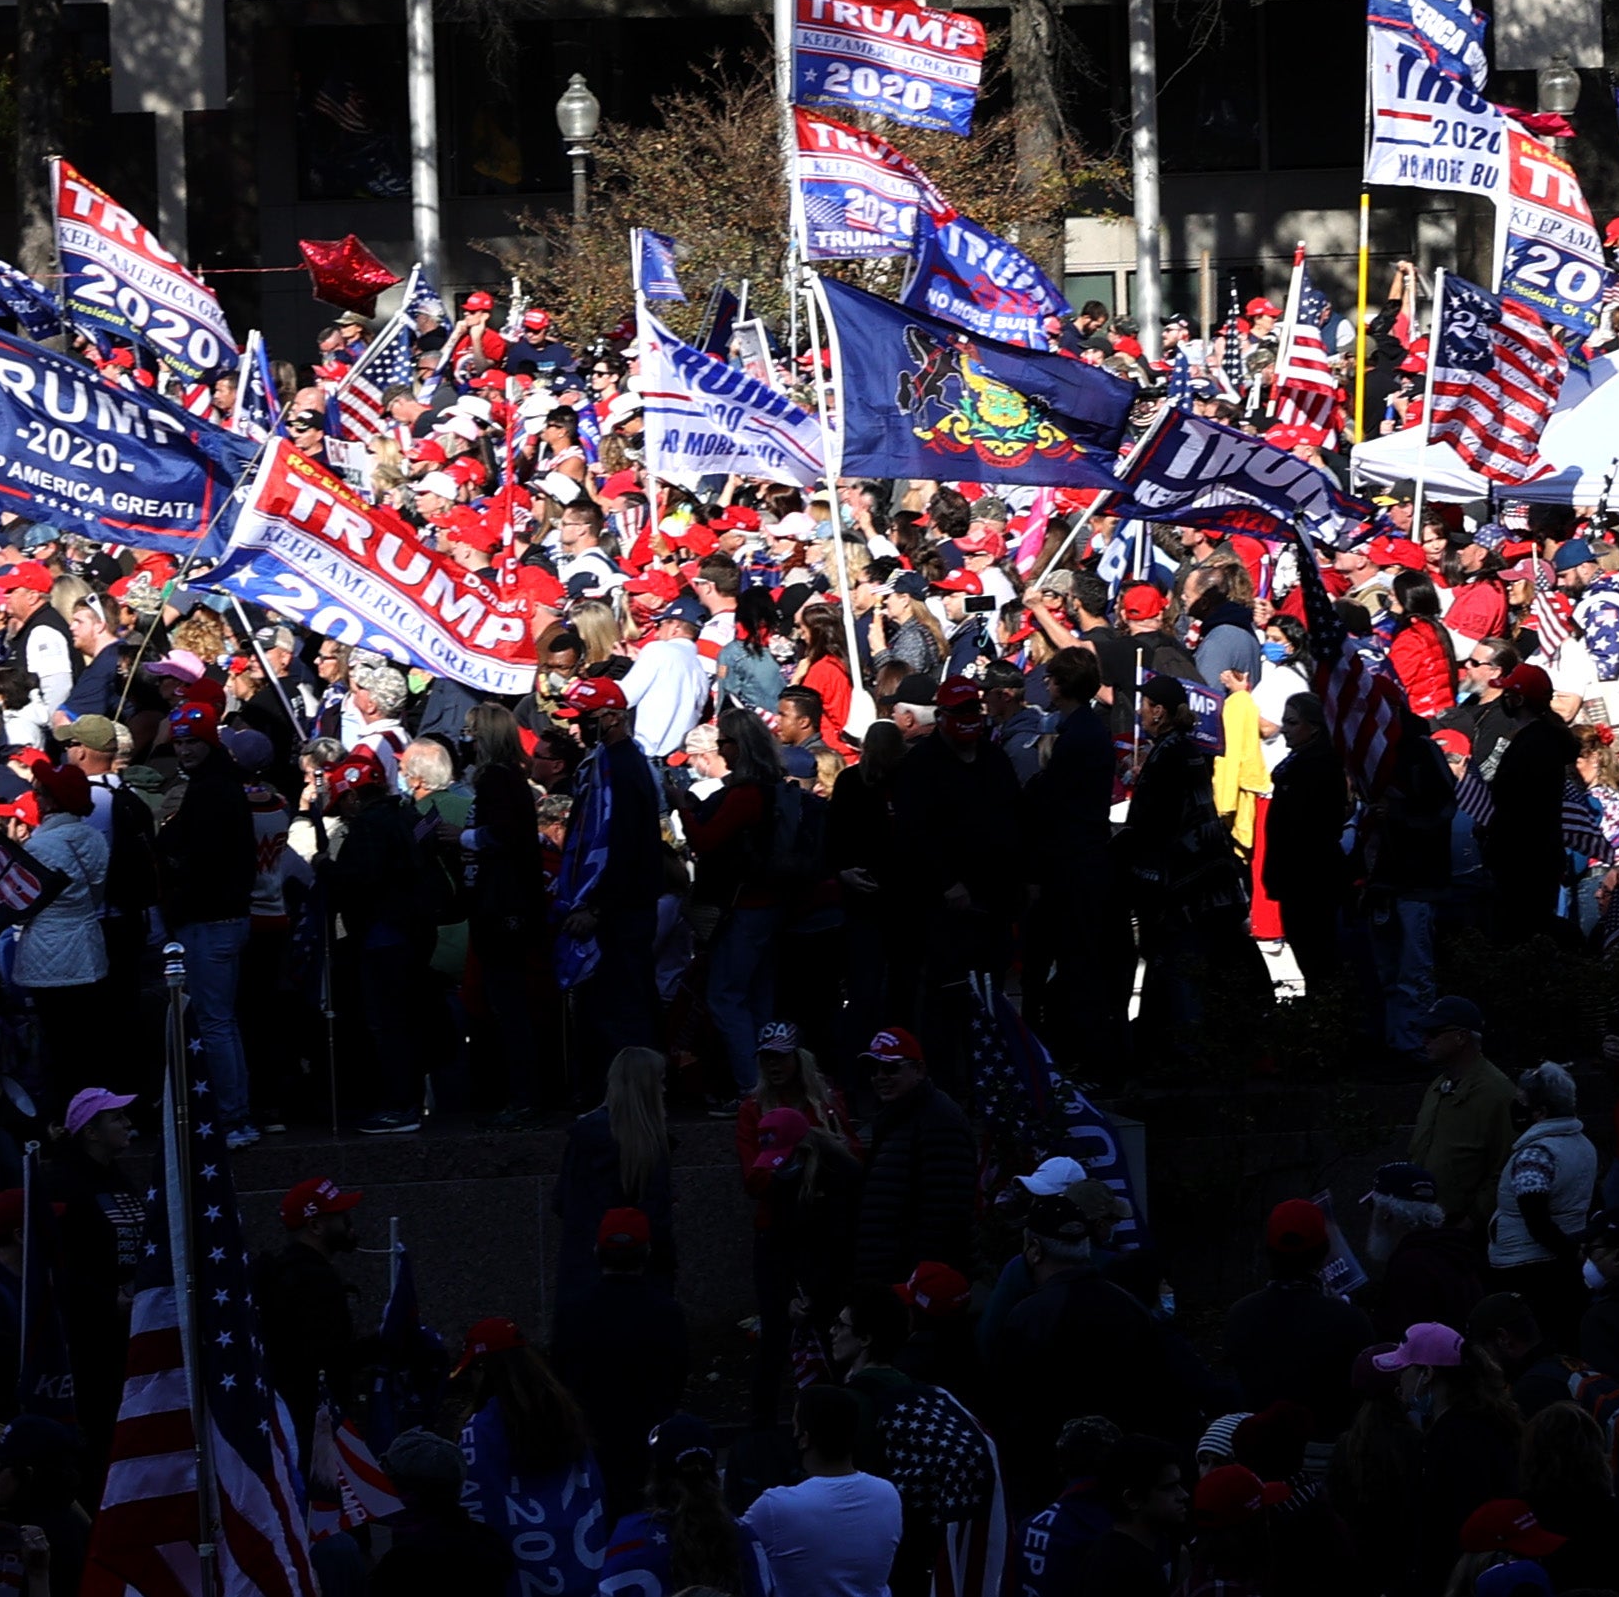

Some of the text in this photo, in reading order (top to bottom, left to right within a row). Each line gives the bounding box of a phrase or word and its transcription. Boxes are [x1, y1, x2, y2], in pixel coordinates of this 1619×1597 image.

[802, 31, 842, 50] KEEP
[823, 62, 932, 110] 2020
[1509, 206, 1562, 234] KEEP
[59, 226, 108, 256] KEEP
[108, 253, 197, 306] AMERICA
[74, 263, 220, 370] 2020
[14, 423, 136, 475] -2020-
[8, 460, 107, 507] AMERICA
[111, 491, 196, 521] GREAT!
[285, 472, 525, 650] TRUMP
[261, 524, 518, 691] KEEP AMERICA GREAT!
